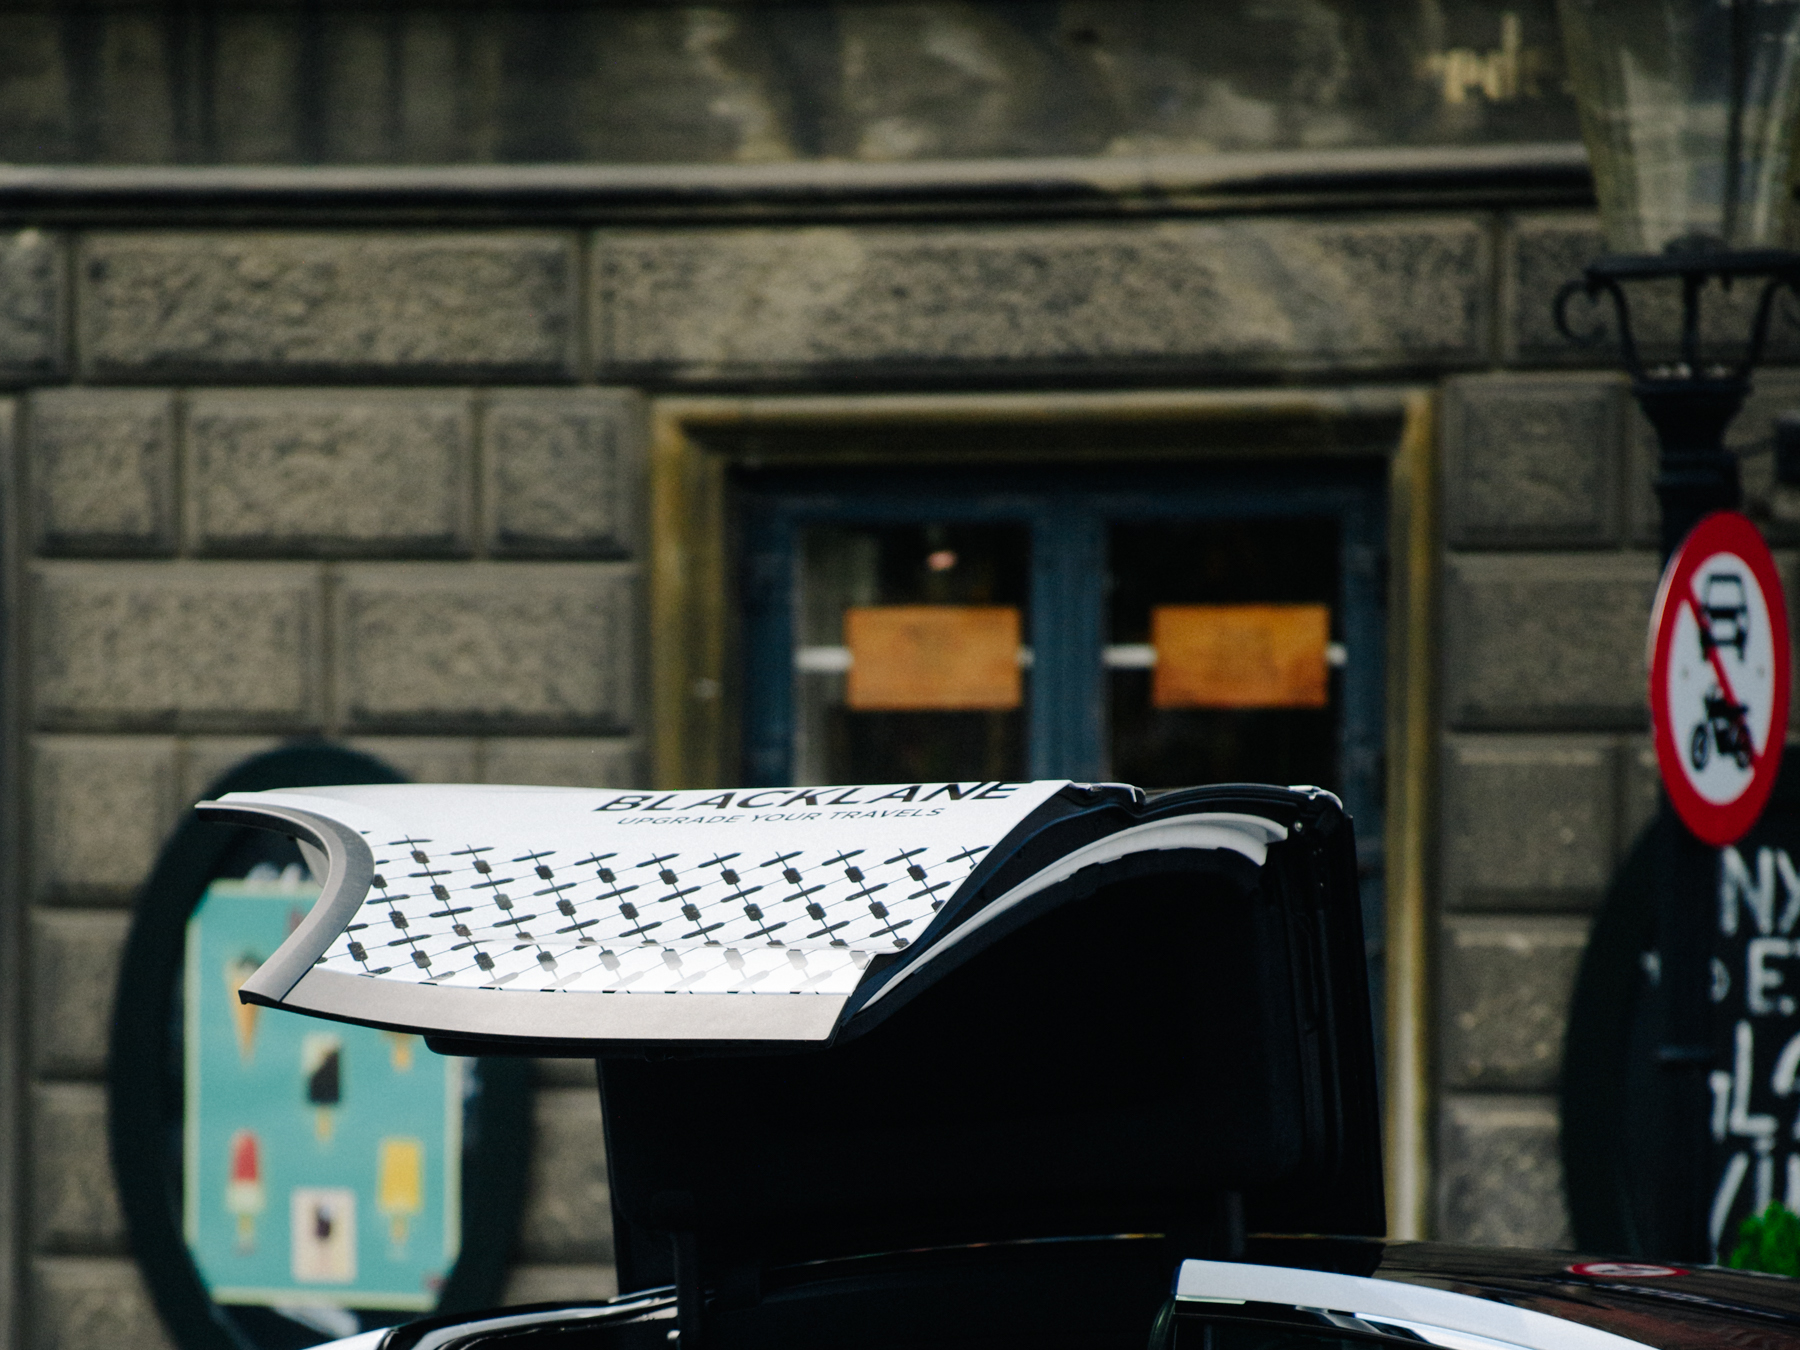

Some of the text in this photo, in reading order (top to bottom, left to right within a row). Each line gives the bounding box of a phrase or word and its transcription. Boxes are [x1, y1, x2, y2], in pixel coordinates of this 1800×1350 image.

[593, 781, 1020, 812] BLACKLANE
[617, 807, 946, 826] UPGRADE YOUR TRAVELS
